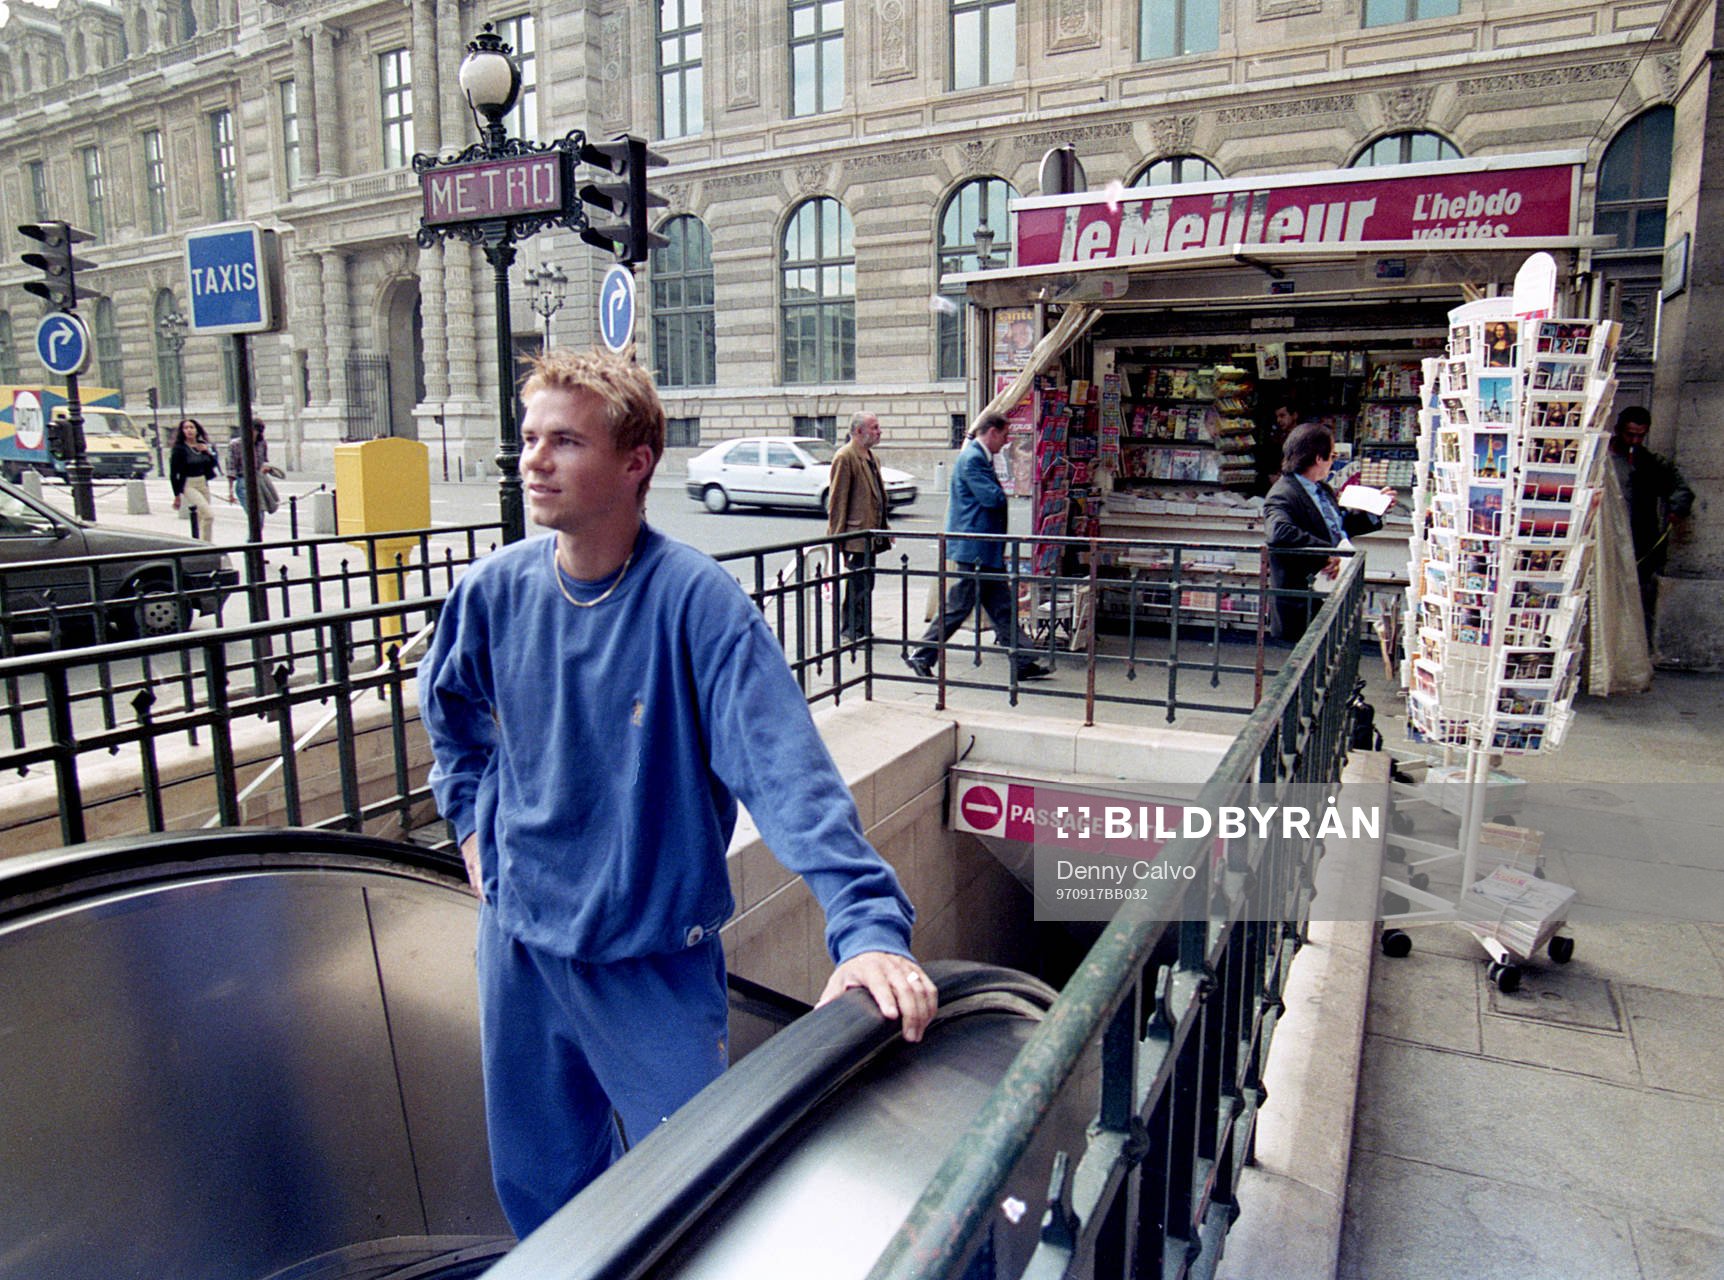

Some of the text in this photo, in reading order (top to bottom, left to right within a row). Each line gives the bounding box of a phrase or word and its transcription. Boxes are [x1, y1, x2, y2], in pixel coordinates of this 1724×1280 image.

[431, 162, 554, 216] METRO
[1412, 188, 1522, 221] L'hebdo
[192, 262, 256, 295] TAXIS
[1010, 804, 1105, 836] PASSAGE
